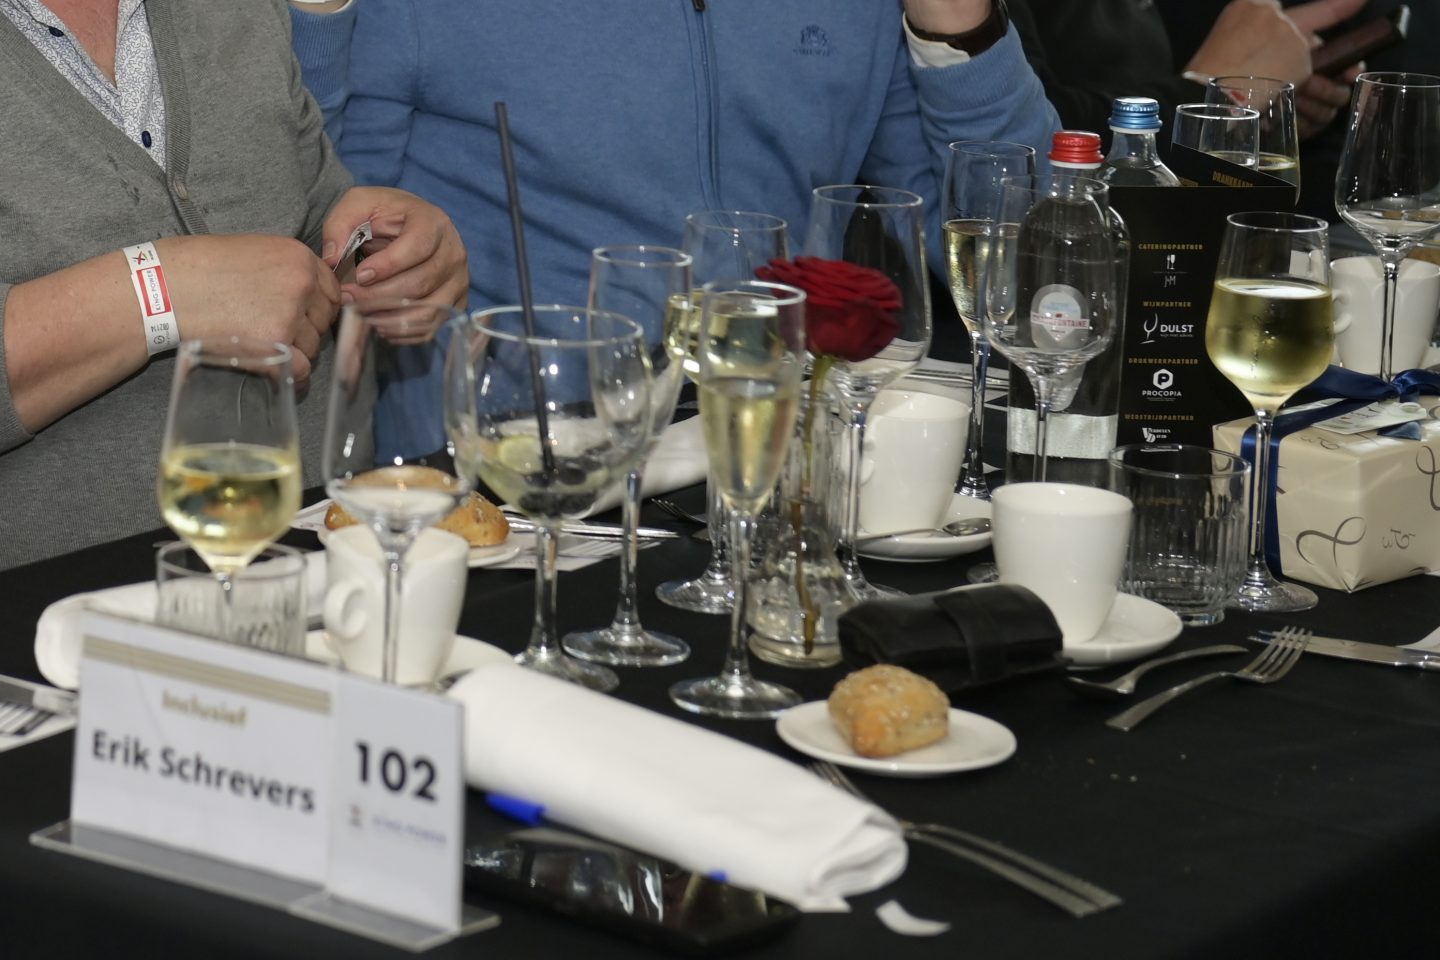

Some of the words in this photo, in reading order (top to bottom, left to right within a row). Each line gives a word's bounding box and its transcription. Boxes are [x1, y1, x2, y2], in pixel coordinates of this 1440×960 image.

[146, 270, 157, 292] POWER
[152, 293, 161, 311] KING
[1160, 324, 1194, 333] DULST
[1128, 357, 1199, 365] DRUKWERKPARTNER
[162, 690, 250, 729] Inclusief
[92, 730, 151, 772] Erik
[159, 746, 317, 815] Schrevers
[354, 739, 439, 804] 102
